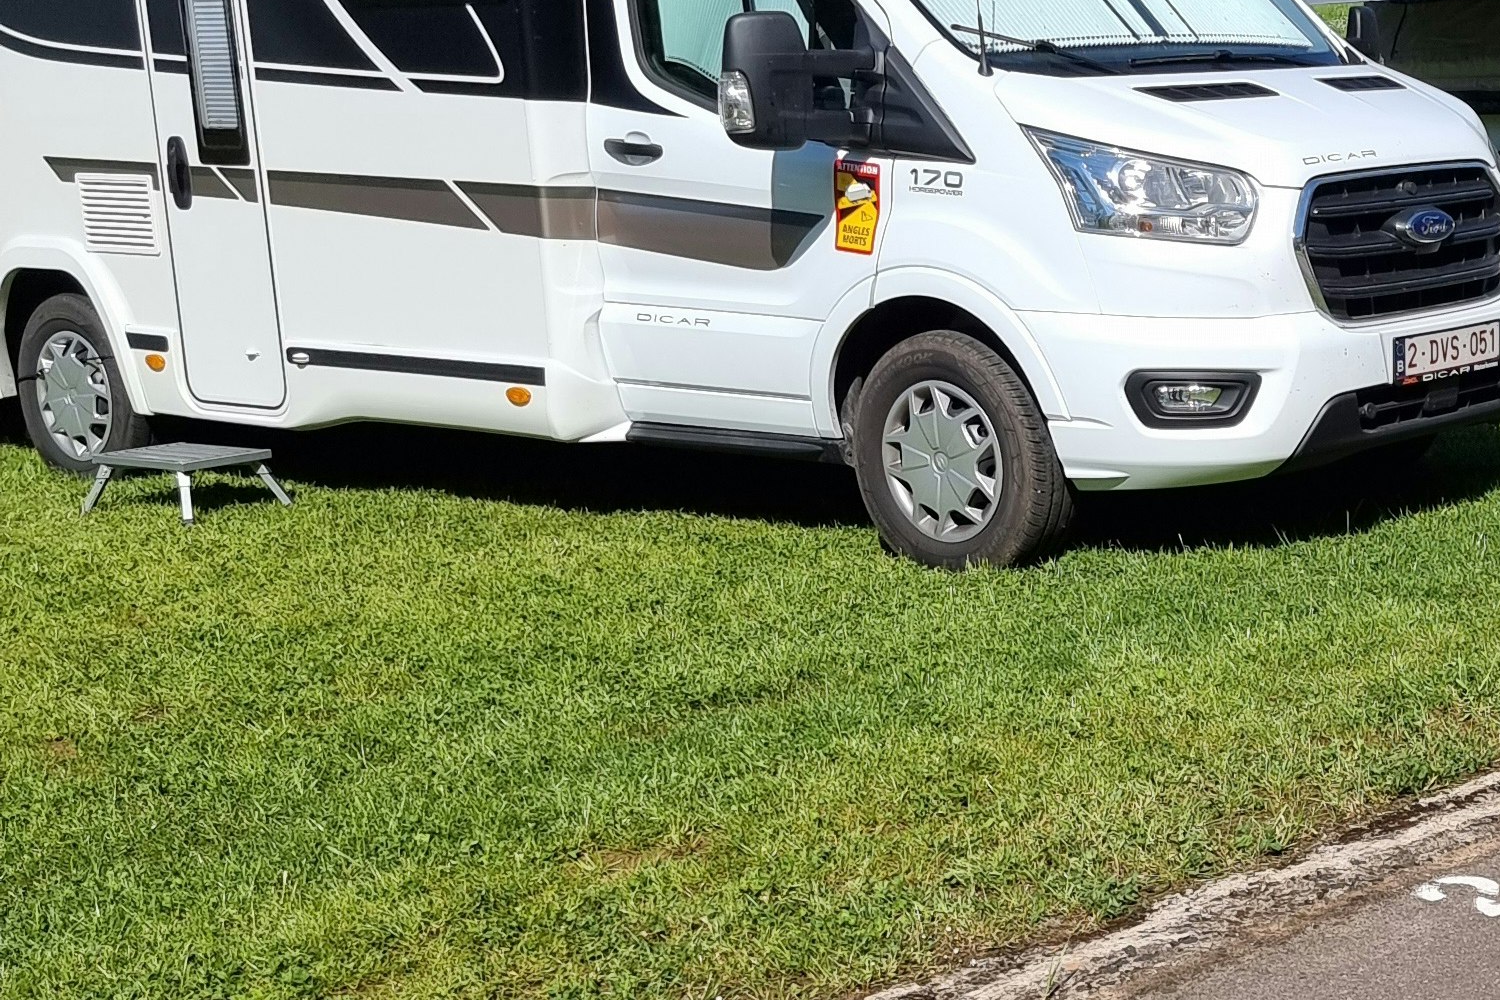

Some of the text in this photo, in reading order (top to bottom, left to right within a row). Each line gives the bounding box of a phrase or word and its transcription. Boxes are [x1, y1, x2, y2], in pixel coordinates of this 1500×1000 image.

[1302, 150, 1378, 165] DICAR
[910, 168, 963, 188] 170
[1421, 215, 1447, 235] Ford
[636, 313, 711, 327] DICAR
[1422, 365, 1471, 382] DICAR
